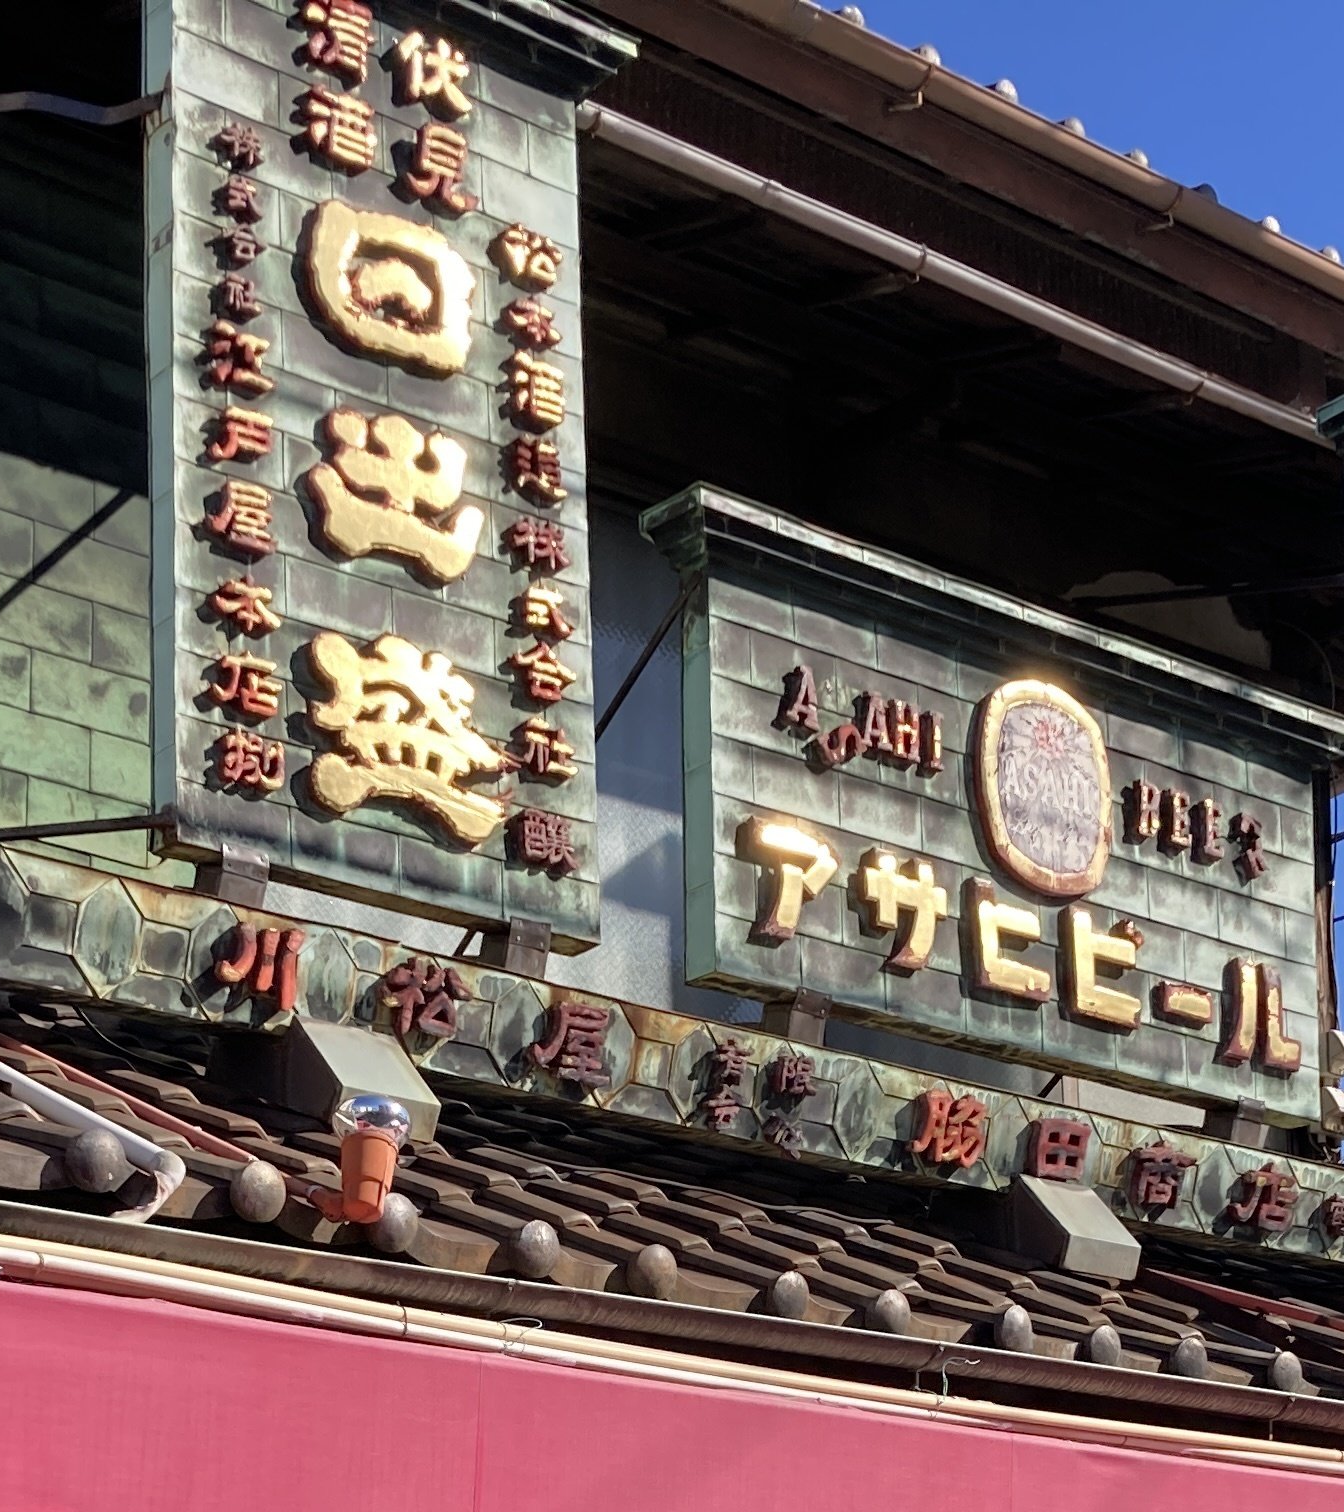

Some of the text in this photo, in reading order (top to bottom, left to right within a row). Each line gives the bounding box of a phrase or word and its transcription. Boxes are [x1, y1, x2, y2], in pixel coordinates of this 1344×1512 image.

[299, 0, 376, 173] 清酒
[394, 30, 478, 213] 伏見
[753, 822, 1303, 1076] アサヒビール
